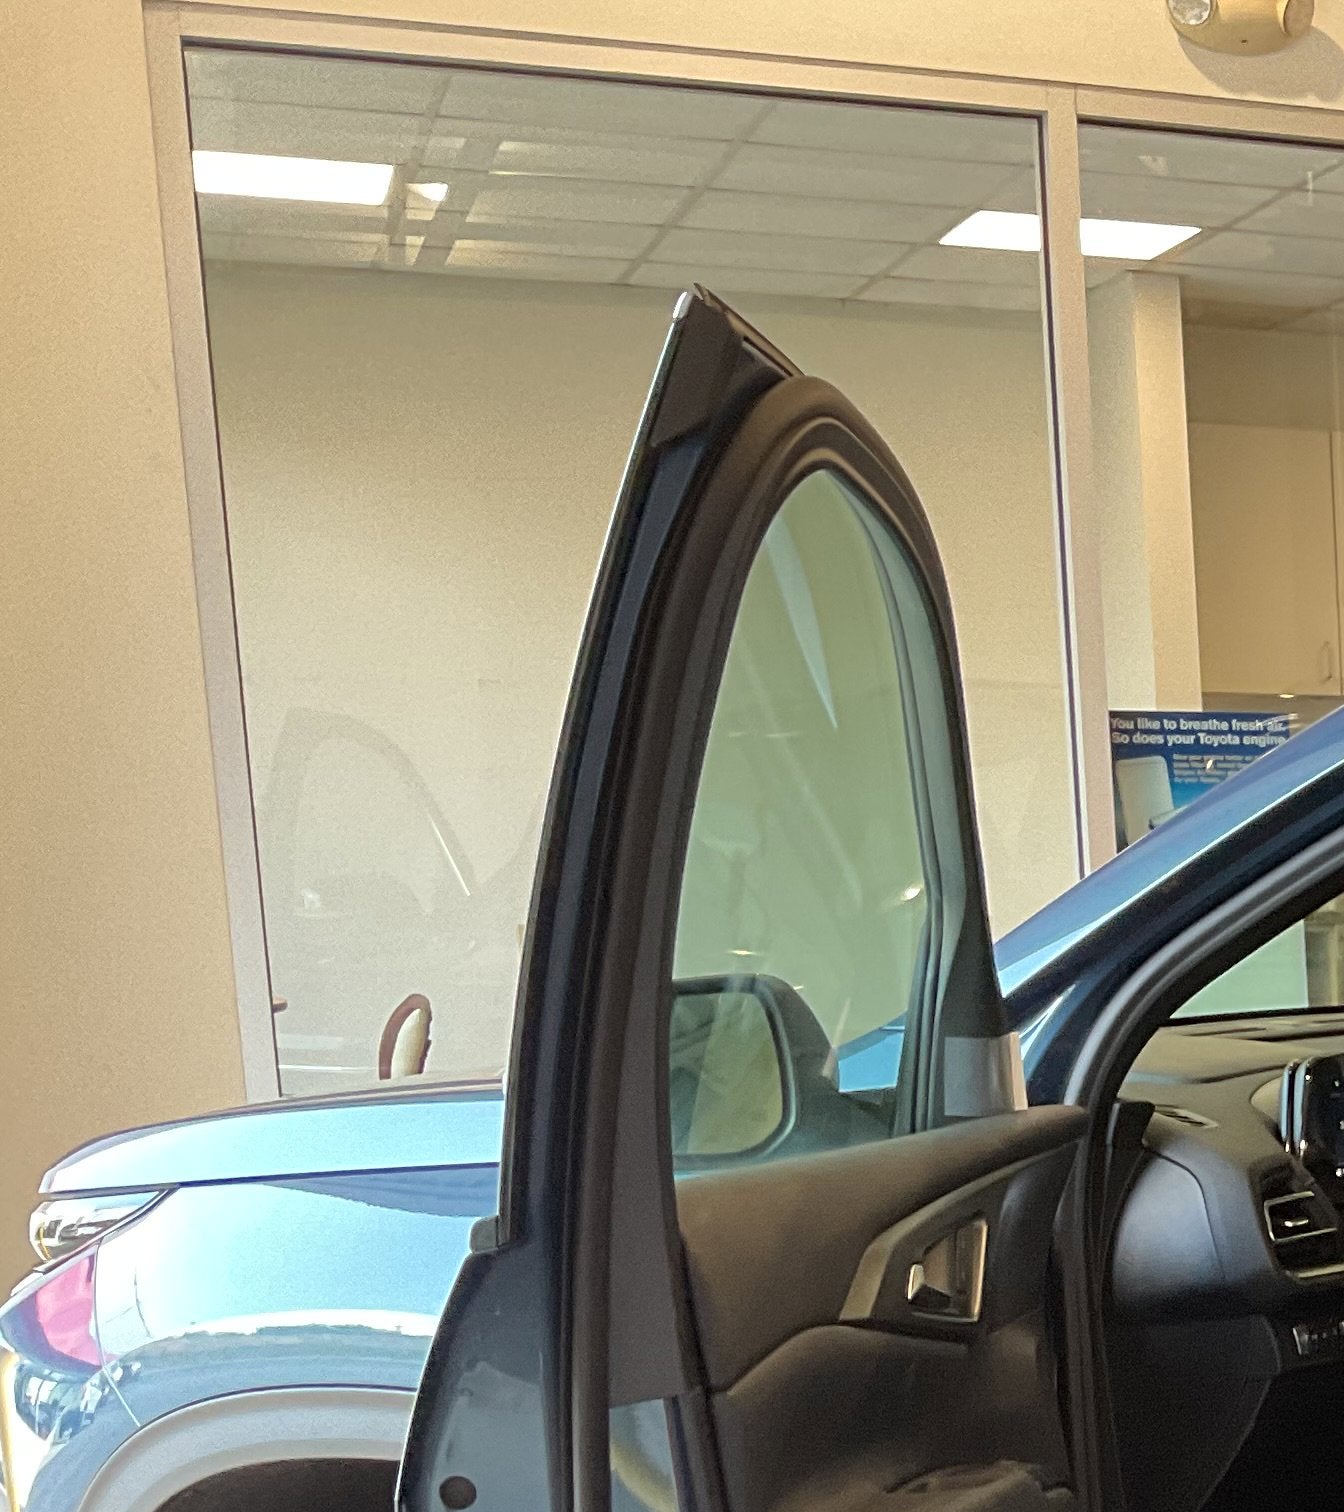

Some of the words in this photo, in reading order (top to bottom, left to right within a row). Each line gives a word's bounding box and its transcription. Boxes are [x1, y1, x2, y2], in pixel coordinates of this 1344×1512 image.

[1111, 718, 1134, 729] You
[1137, 717, 1160, 730] like
[1163, 718, 1177, 730] to
[1180, 718, 1229, 731] breathe
[1231, 718, 1263, 731] fresh
[1112, 732, 1130, 744] So
[1132, 731, 1164, 744] does
[1166, 735, 1195, 747] your
[1197, 732, 1239, 747] Toyota
